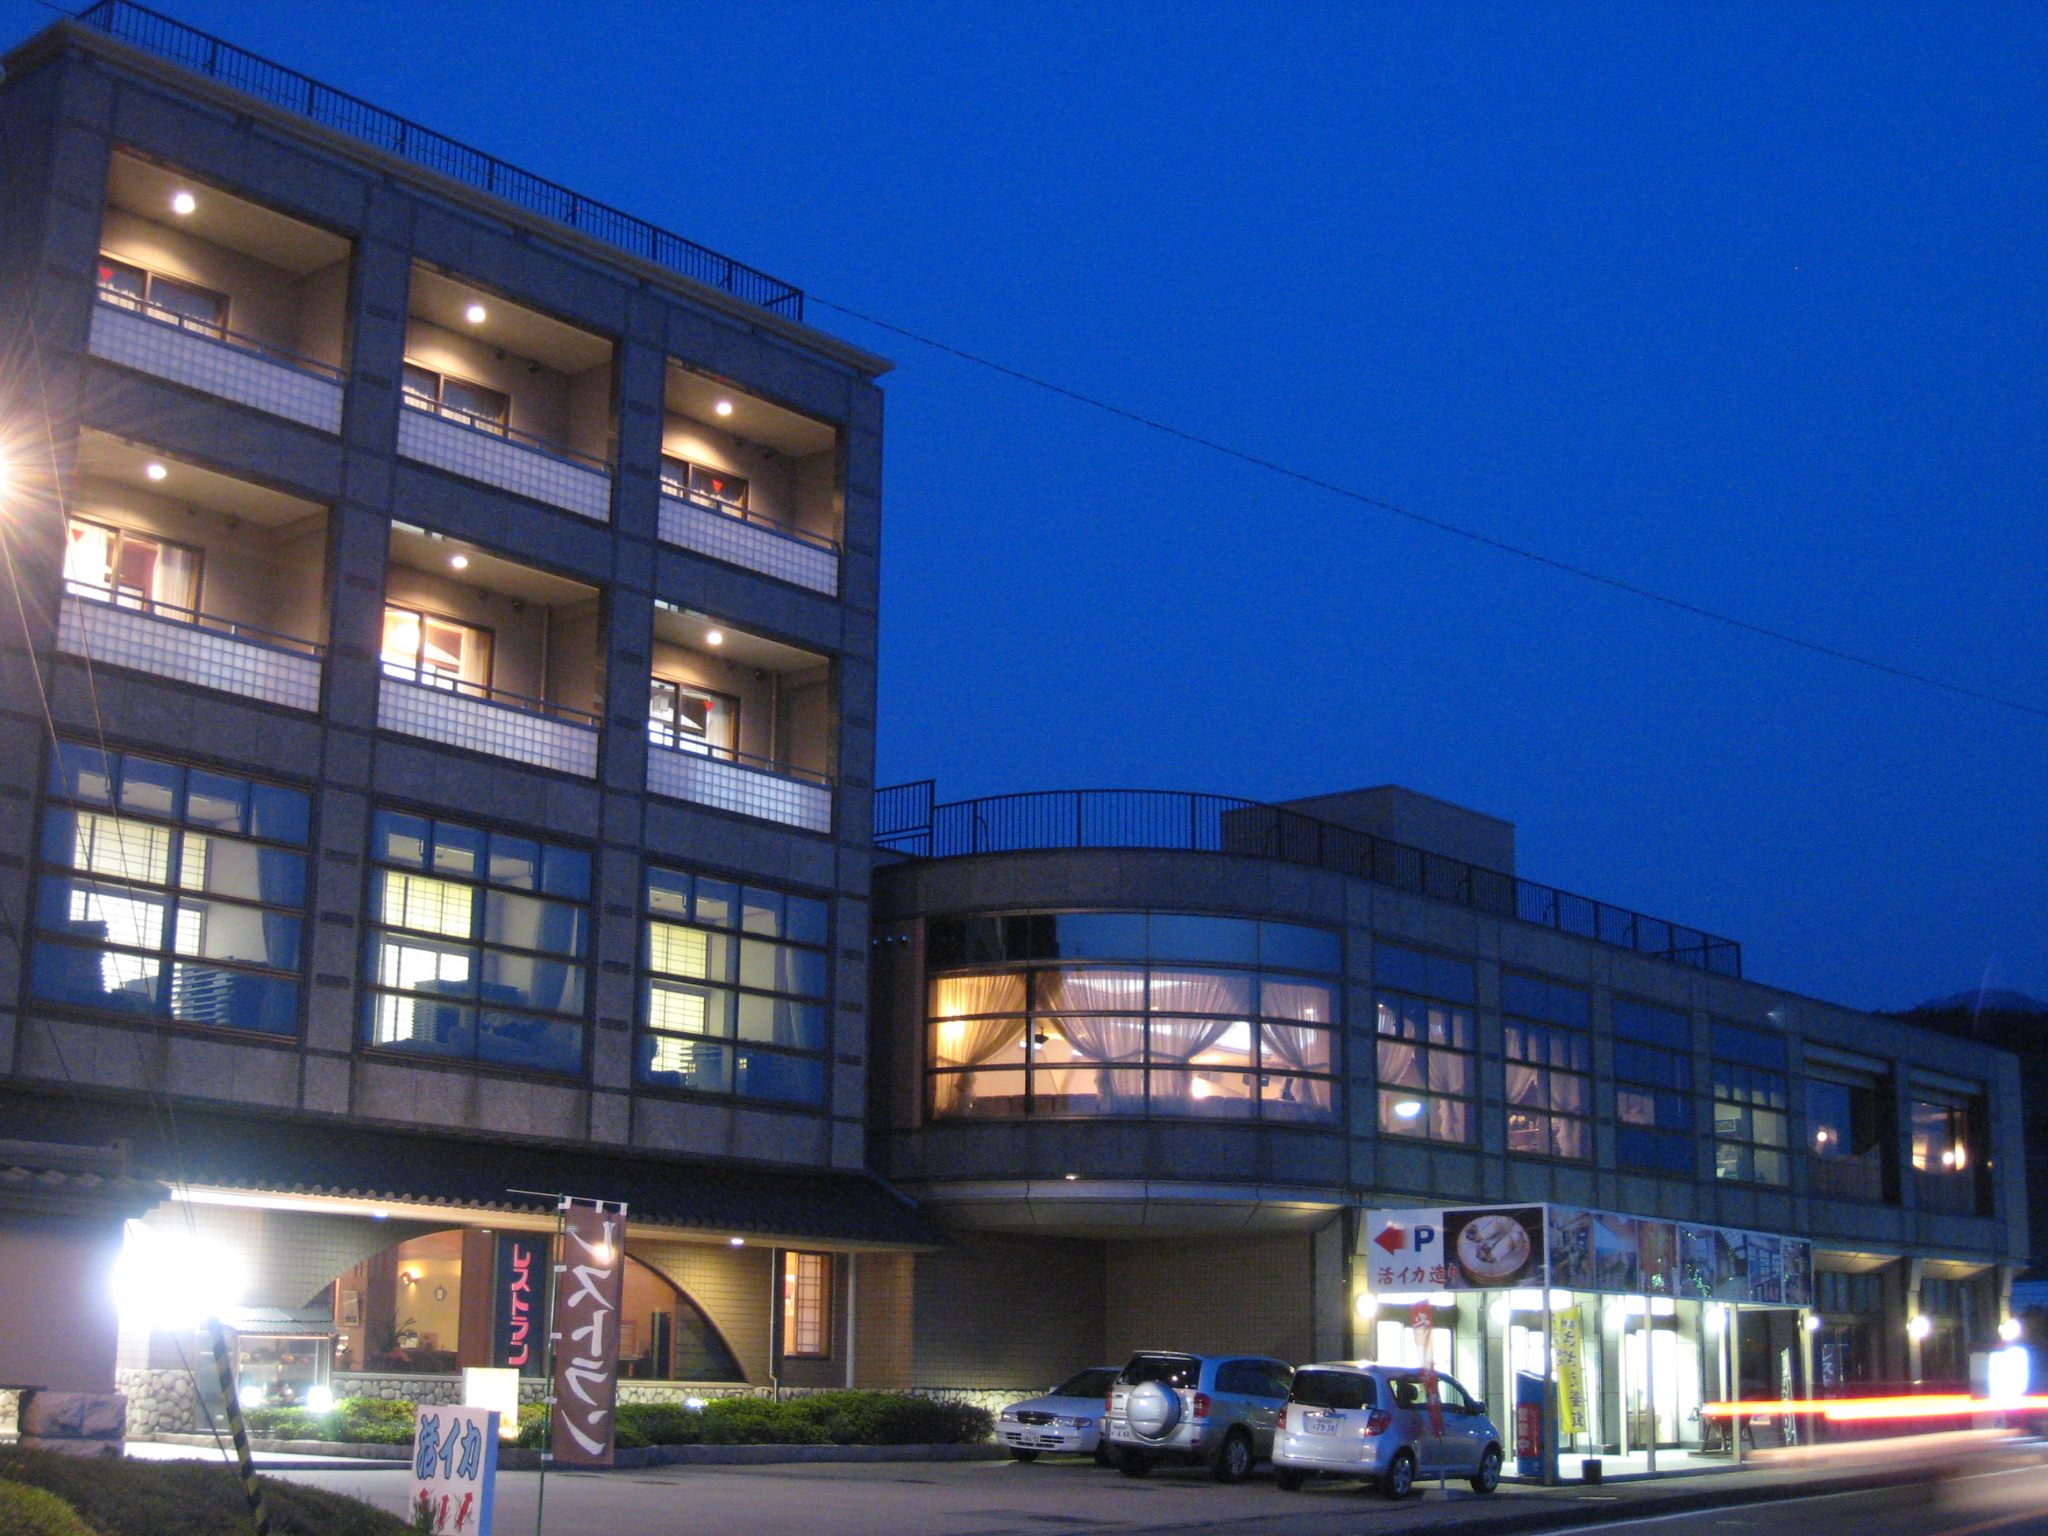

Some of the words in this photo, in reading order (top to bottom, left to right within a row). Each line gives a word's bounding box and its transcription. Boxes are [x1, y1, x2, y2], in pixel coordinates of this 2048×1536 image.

[1413, 1224, 1436, 1253] P
[508, 1242, 531, 1367] レストラン
